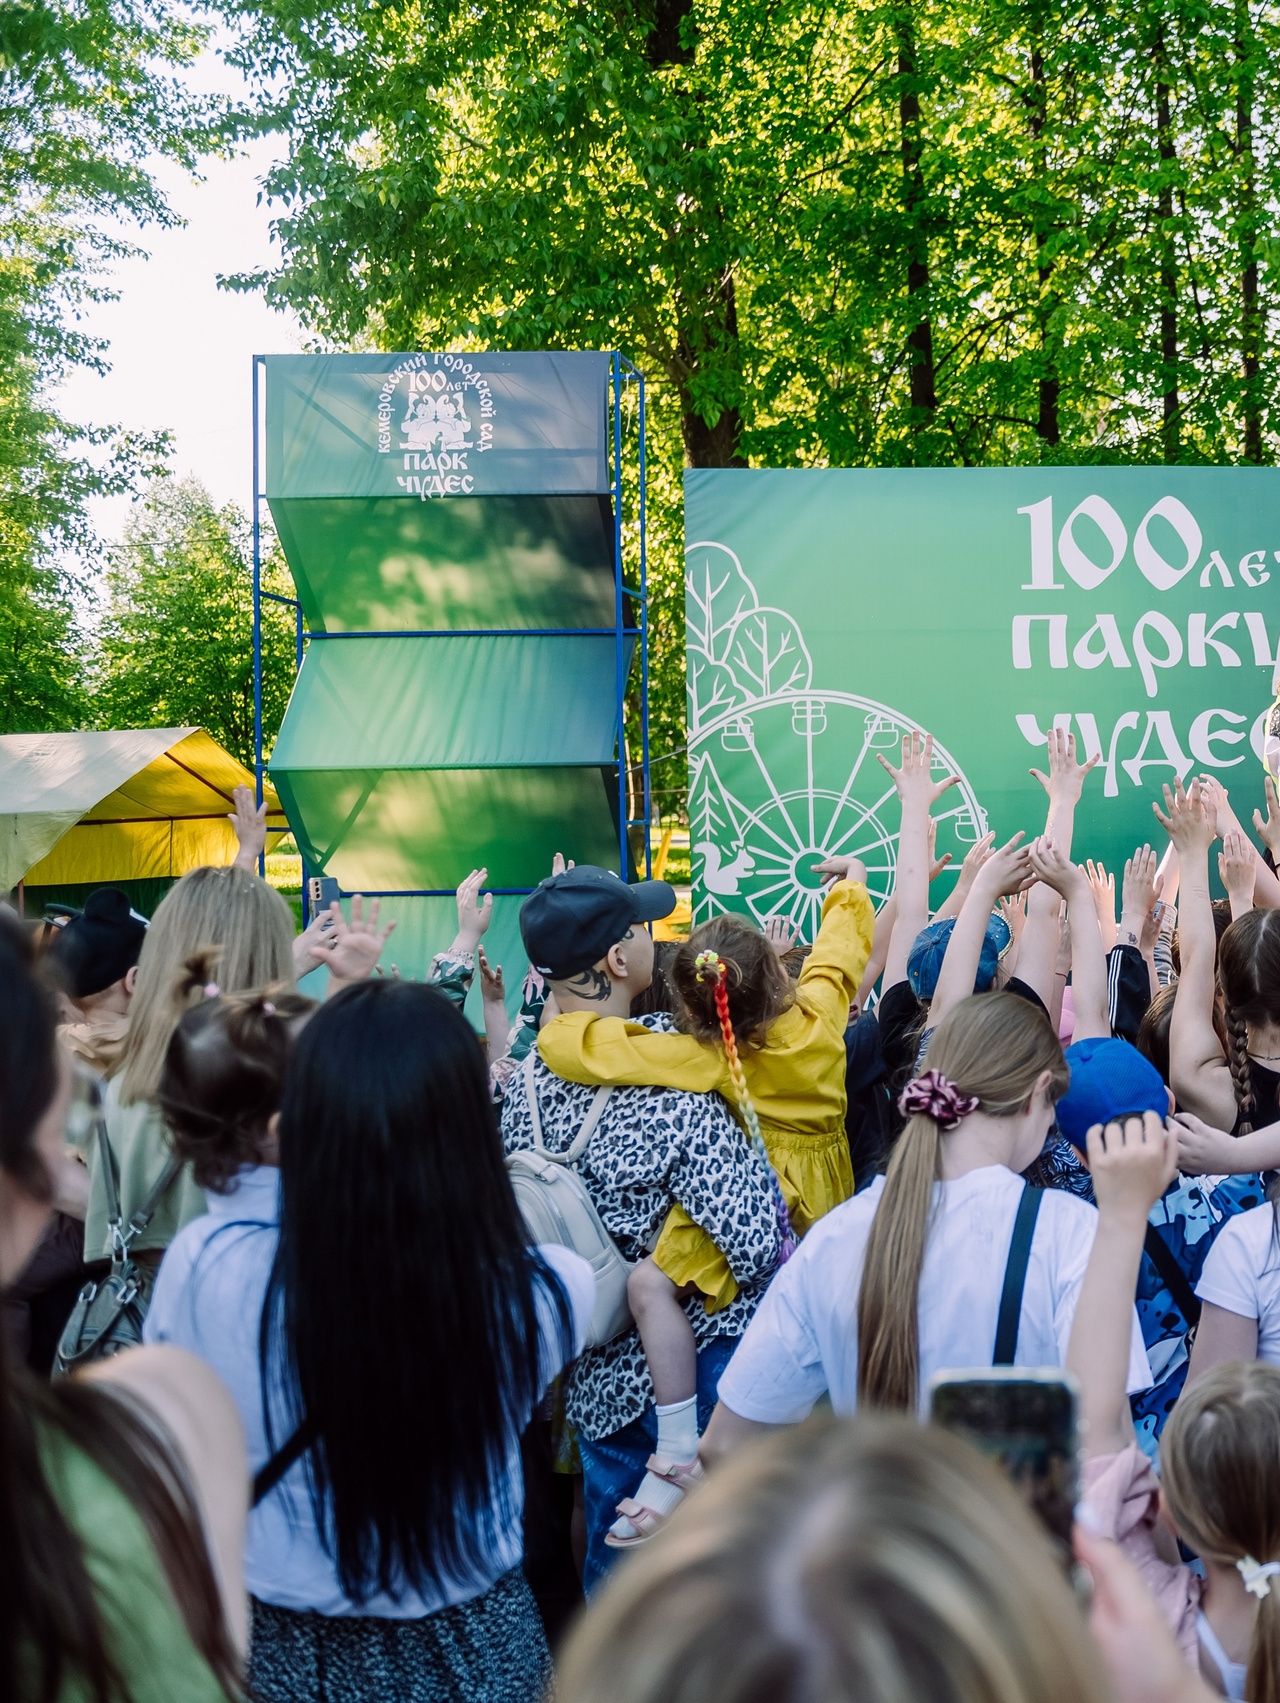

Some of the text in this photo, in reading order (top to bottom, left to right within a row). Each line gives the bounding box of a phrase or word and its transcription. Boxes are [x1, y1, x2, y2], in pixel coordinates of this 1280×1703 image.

[378, 352, 497, 453] КЕМЕРОВСКИЙ ГОРОДСКОЙ САД
[408, 370, 447, 393] 100
[396, 475, 475, 502] ЧУДЕС
[403, 451, 468, 479] ПАРК
[1016, 494, 1203, 591] 100
[1015, 708, 1270, 798] ЧУДЕ
